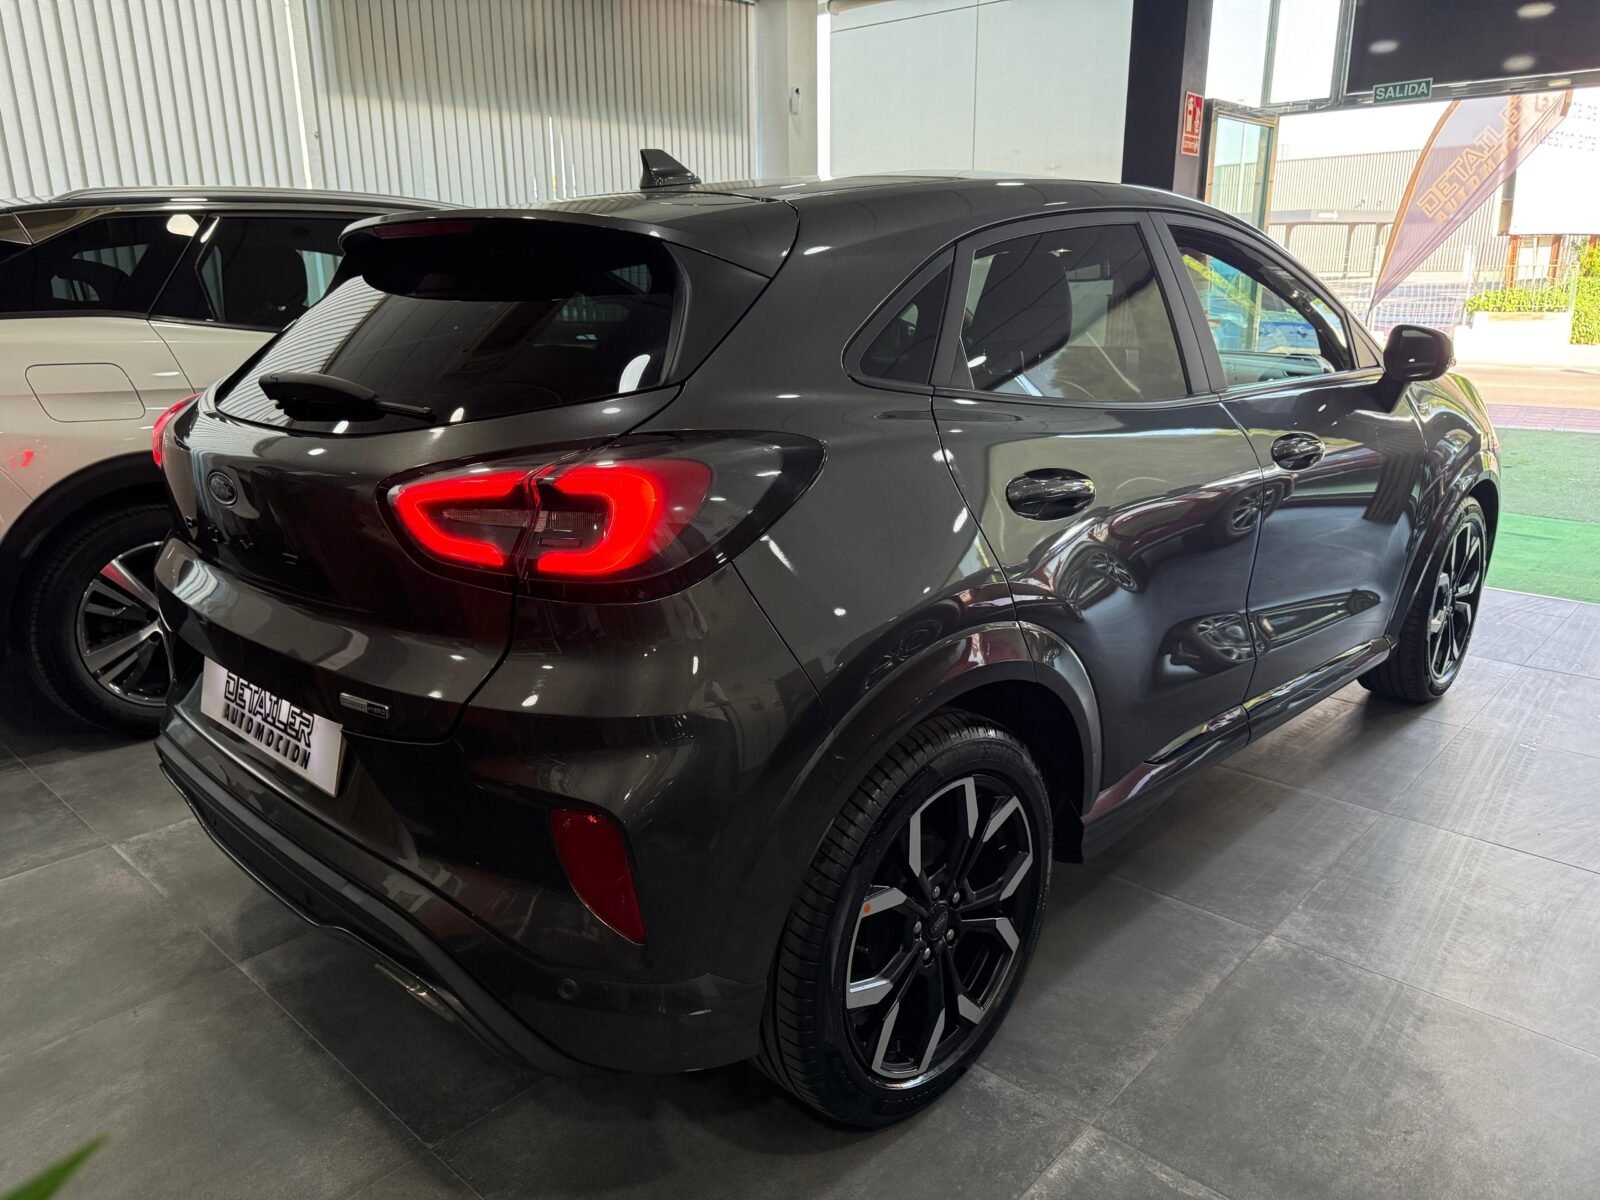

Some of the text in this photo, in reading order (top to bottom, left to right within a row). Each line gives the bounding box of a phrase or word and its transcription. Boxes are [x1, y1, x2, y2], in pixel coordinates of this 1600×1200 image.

[1375, 82, 1428, 99] SALIDA
[222, 703, 311, 769] AUTOMOCION
[225, 671, 314, 748] DETAILER
